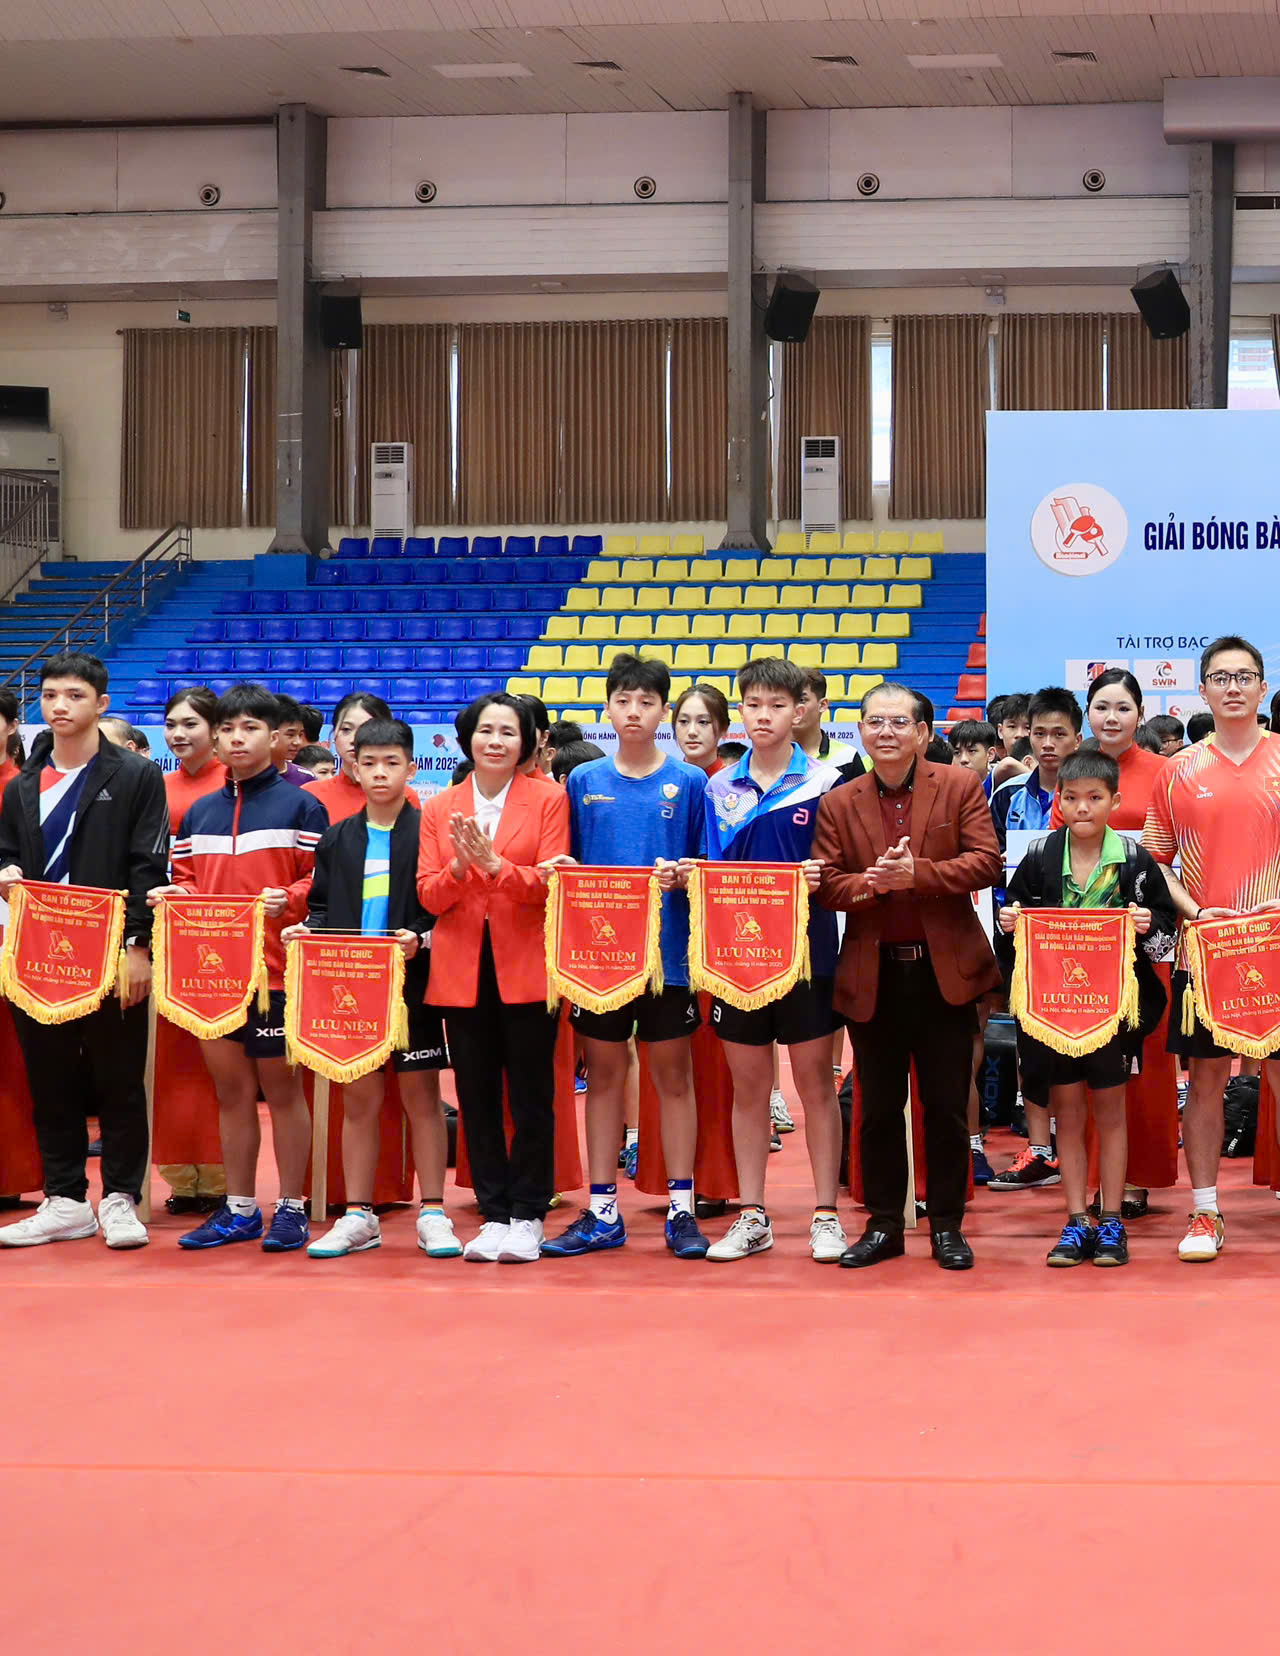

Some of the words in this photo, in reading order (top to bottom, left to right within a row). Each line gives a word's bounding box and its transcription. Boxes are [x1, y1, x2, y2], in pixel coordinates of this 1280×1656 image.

[1144, 513, 1185, 551] GIẢI
[1192, 515, 1249, 550] BÓNG
[1116, 634, 1140, 649] TÀI
[1144, 636, 1174, 651] TRỢ
[1178, 636, 1209, 651] BẠC
[1152, 678, 1177, 686] SWIN
[598, 730, 617, 740] HÀNH
[435, 757, 458, 771] 2025
[578, 880, 595, 888] BAN
[597, 877, 608, 888] TỔ
[610, 879, 631, 889] CHỨC
[722, 875, 738, 884] BAN
[741, 873, 752, 884] TỔ
[753, 874, 775, 884] CHỨC
[41, 893, 58, 906] BAN
[59, 892, 70, 907] TỔ
[71, 895, 93, 909] CHỨC
[186, 908, 201, 916] BAN
[204, 906, 214, 917] TỔ
[215, 907, 235, 917] CHỨC
[1217, 926, 1234, 938] BAN
[1235, 922, 1247, 935] TỔ
[1247, 920, 1270, 933] CHỨC
[320, 949, 336, 957] BAN
[339, 947, 349, 958] TỔ
[351, 948, 372, 958] CHỨC
[571, 950, 599, 961] LƯU
[602, 950, 635, 962] NIỆM
[716, 947, 745, 958] LƯU
[747, 947, 782, 959] NIỆM
[26, 961, 54, 974] LƯU
[56, 963, 92, 979] NIỆM
[182, 979, 208, 989] LƯU
[210, 978, 241, 990] NIỆM
[1043, 993, 1071, 1004] LƯU
[1074, 992, 1108, 1005] NIỆM
[1221, 997, 1250, 1011] LƯU
[312, 1019, 340, 1030] LƯU
[343, 1019, 377, 1032] NIỆM
[402, 1048, 442, 1062] XIOM
